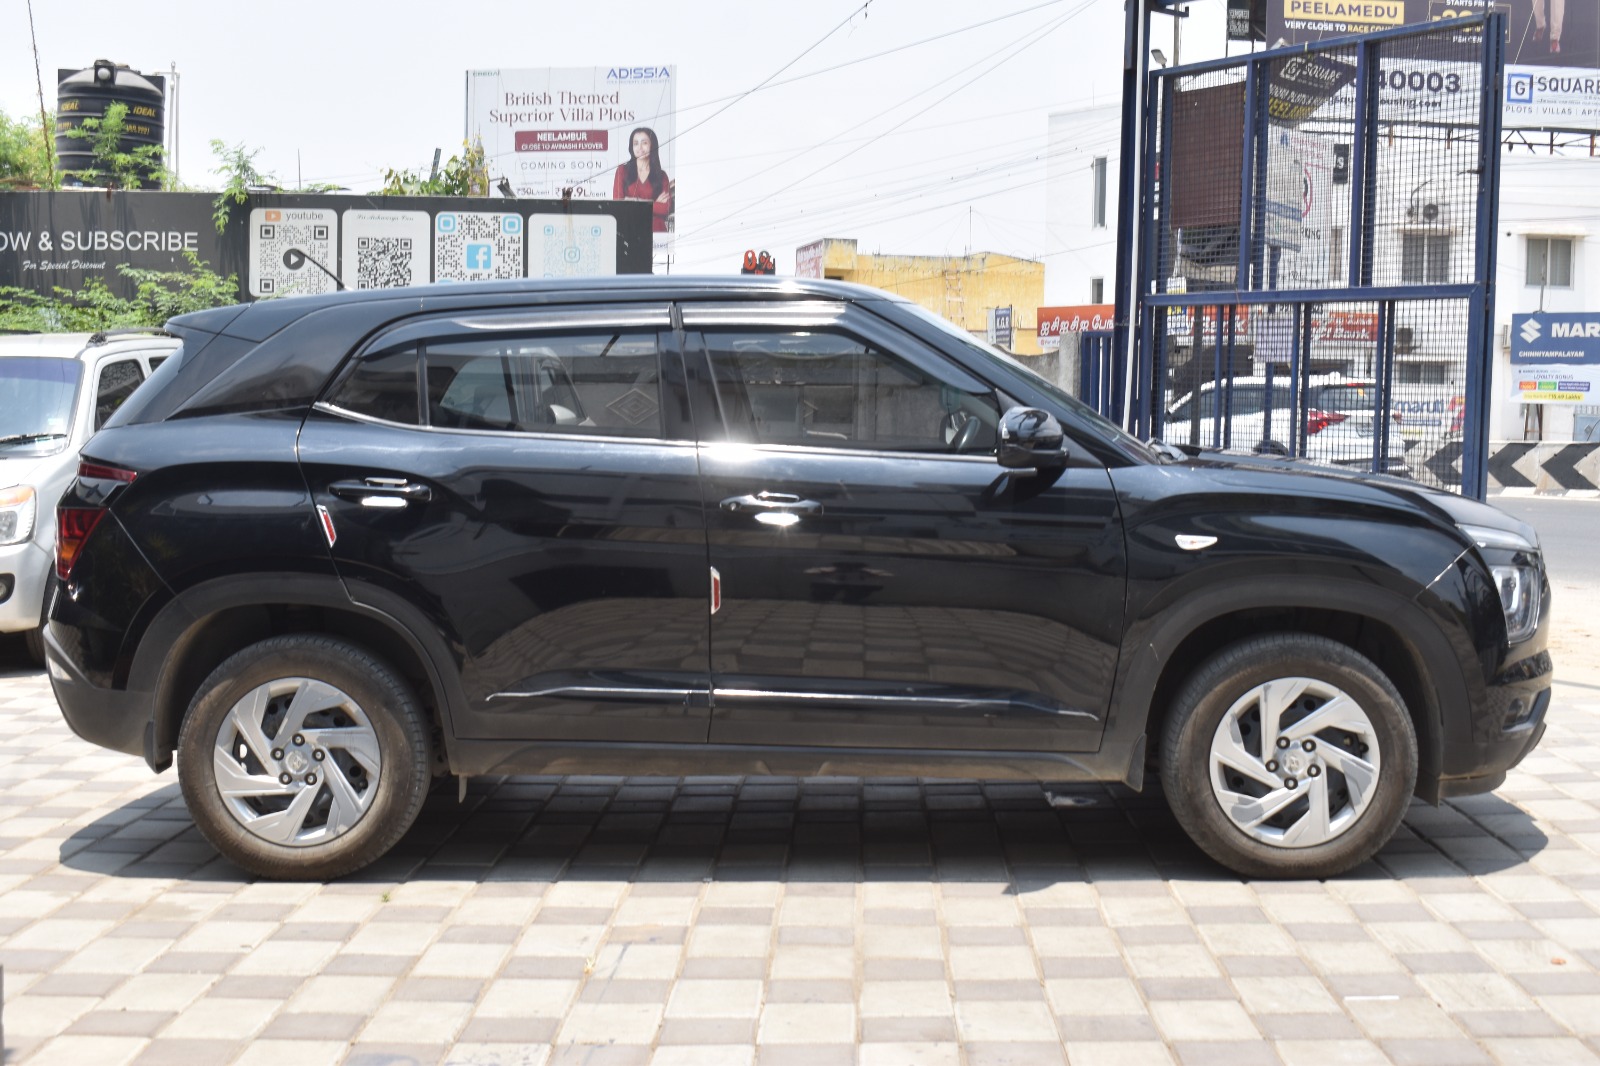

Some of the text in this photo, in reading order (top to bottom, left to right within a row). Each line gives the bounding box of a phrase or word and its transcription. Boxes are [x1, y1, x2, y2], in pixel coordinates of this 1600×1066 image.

[1291, 0, 1398, 18] PEELAMEDU
[1474, 0, 1494, 8] FRM
[1284, 20, 1306, 30] VERY
[1307, 21, 1334, 31] CLOSE
[1335, 22, 1346, 32] TO
[1347, 24, 1369, 33] RACE
[606, 66, 670, 79] ADISSIA
[505, 91, 619, 106] British Themed
[133, 105, 156, 118] IDEAL
[1505, 105, 1533, 113] PLOTS
[1542, 107, 1572, 115] VILLAS
[489, 107, 635, 127] Superior Villa Plots
[537, 132, 588, 142] NEELAMBUR
[520, 160, 602, 171] COMING SOON
[286, 211, 324, 222] youtube
[38, 230, 53, 251] &
[60, 231, 198, 252] SUBSCRIBE
[22, 259, 106, 272] For Special Discount
[1551, 322, 1600, 338] MAR
